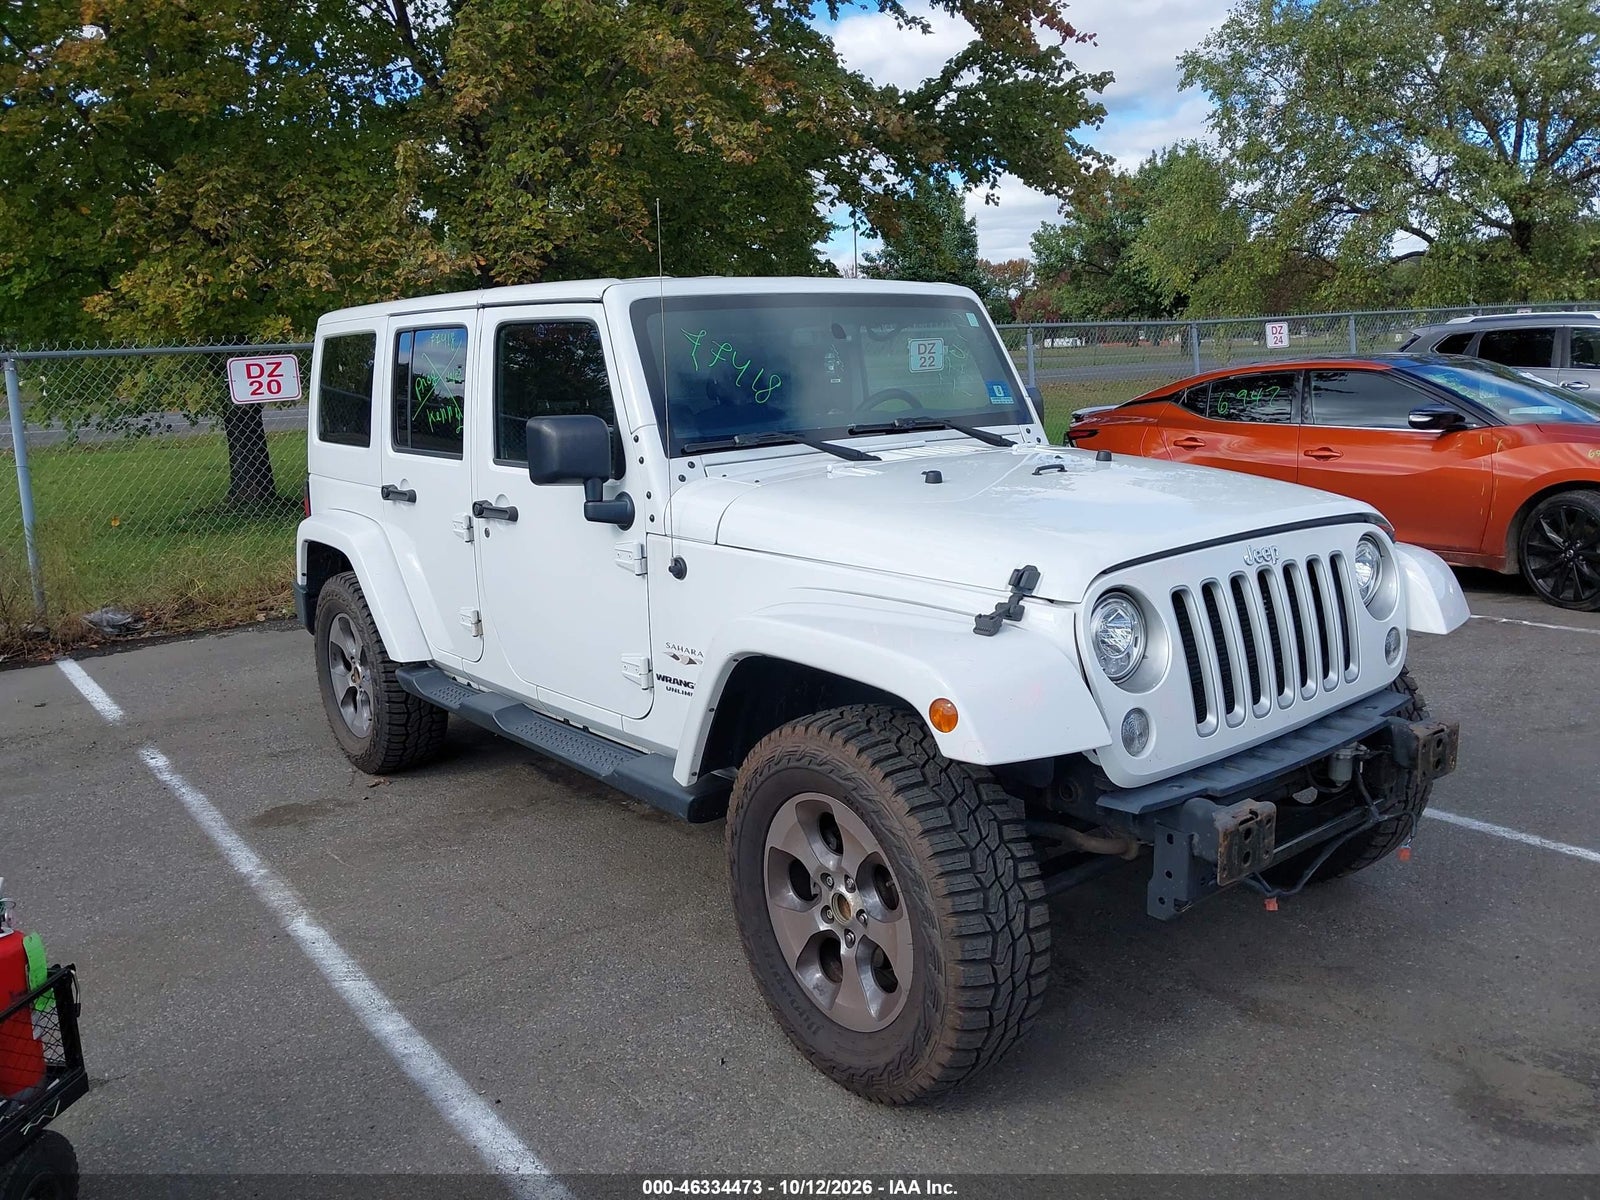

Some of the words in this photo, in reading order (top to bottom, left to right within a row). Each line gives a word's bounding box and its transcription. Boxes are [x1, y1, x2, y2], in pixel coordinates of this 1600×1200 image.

[1271, 325, 1284, 335] DZ
[1273, 335, 1283, 345] 24
[917, 342, 937, 355] DZ
[919, 356, 936, 368] 22
[245, 361, 284, 379] DZ
[248, 379, 282, 396] 20
[1217, 385, 1281, 414] 6947
[1243, 544, 1280, 566] Jeep
[665, 642, 704, 656] SAHARA
[656, 673, 696, 689] WRANG
